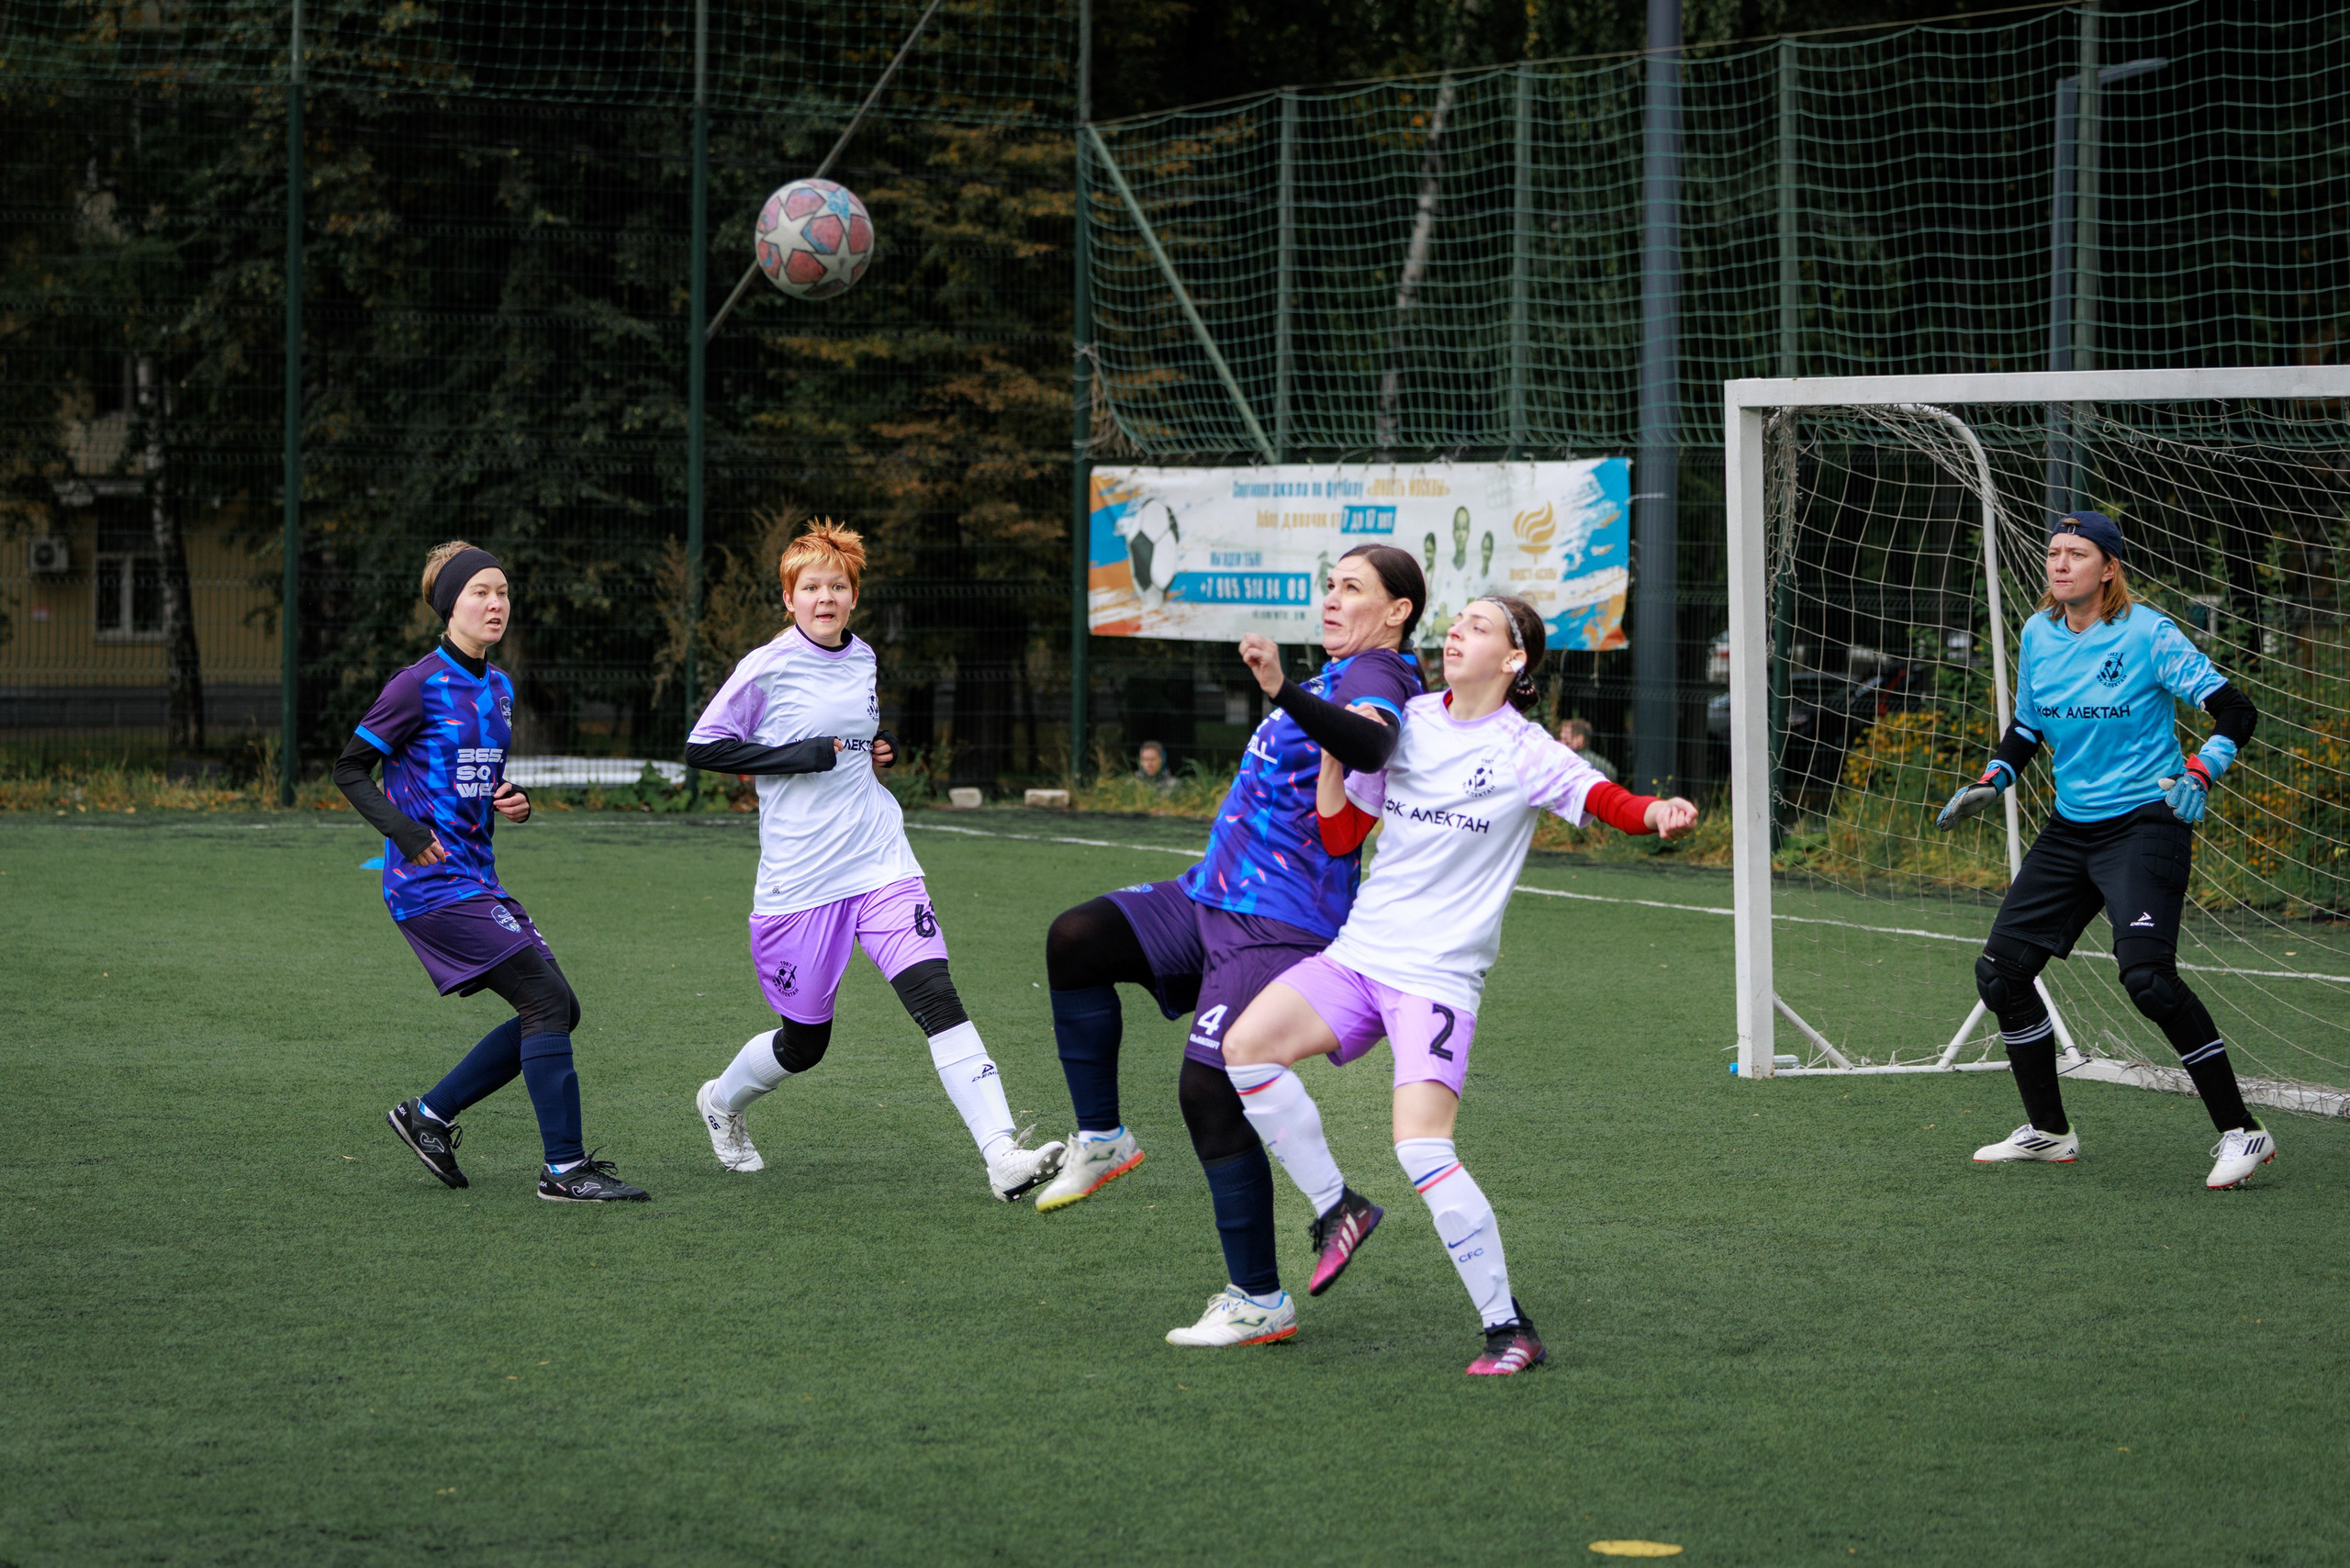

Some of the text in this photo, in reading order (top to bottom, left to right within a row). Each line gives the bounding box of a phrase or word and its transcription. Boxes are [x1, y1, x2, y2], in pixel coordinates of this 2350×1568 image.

[2065, 705, 2131, 719] АЛЕКТАН
[456, 747, 505, 764] 365.
[456, 765, 491, 781] SO
[456, 782, 499, 798] WEL
[1410, 807, 1490, 834] АЛЕКТАН
[1197, 1003, 1228, 1036] 4
[1429, 1002, 1455, 1062] 2
[1459, 1248, 1483, 1262] CFC
